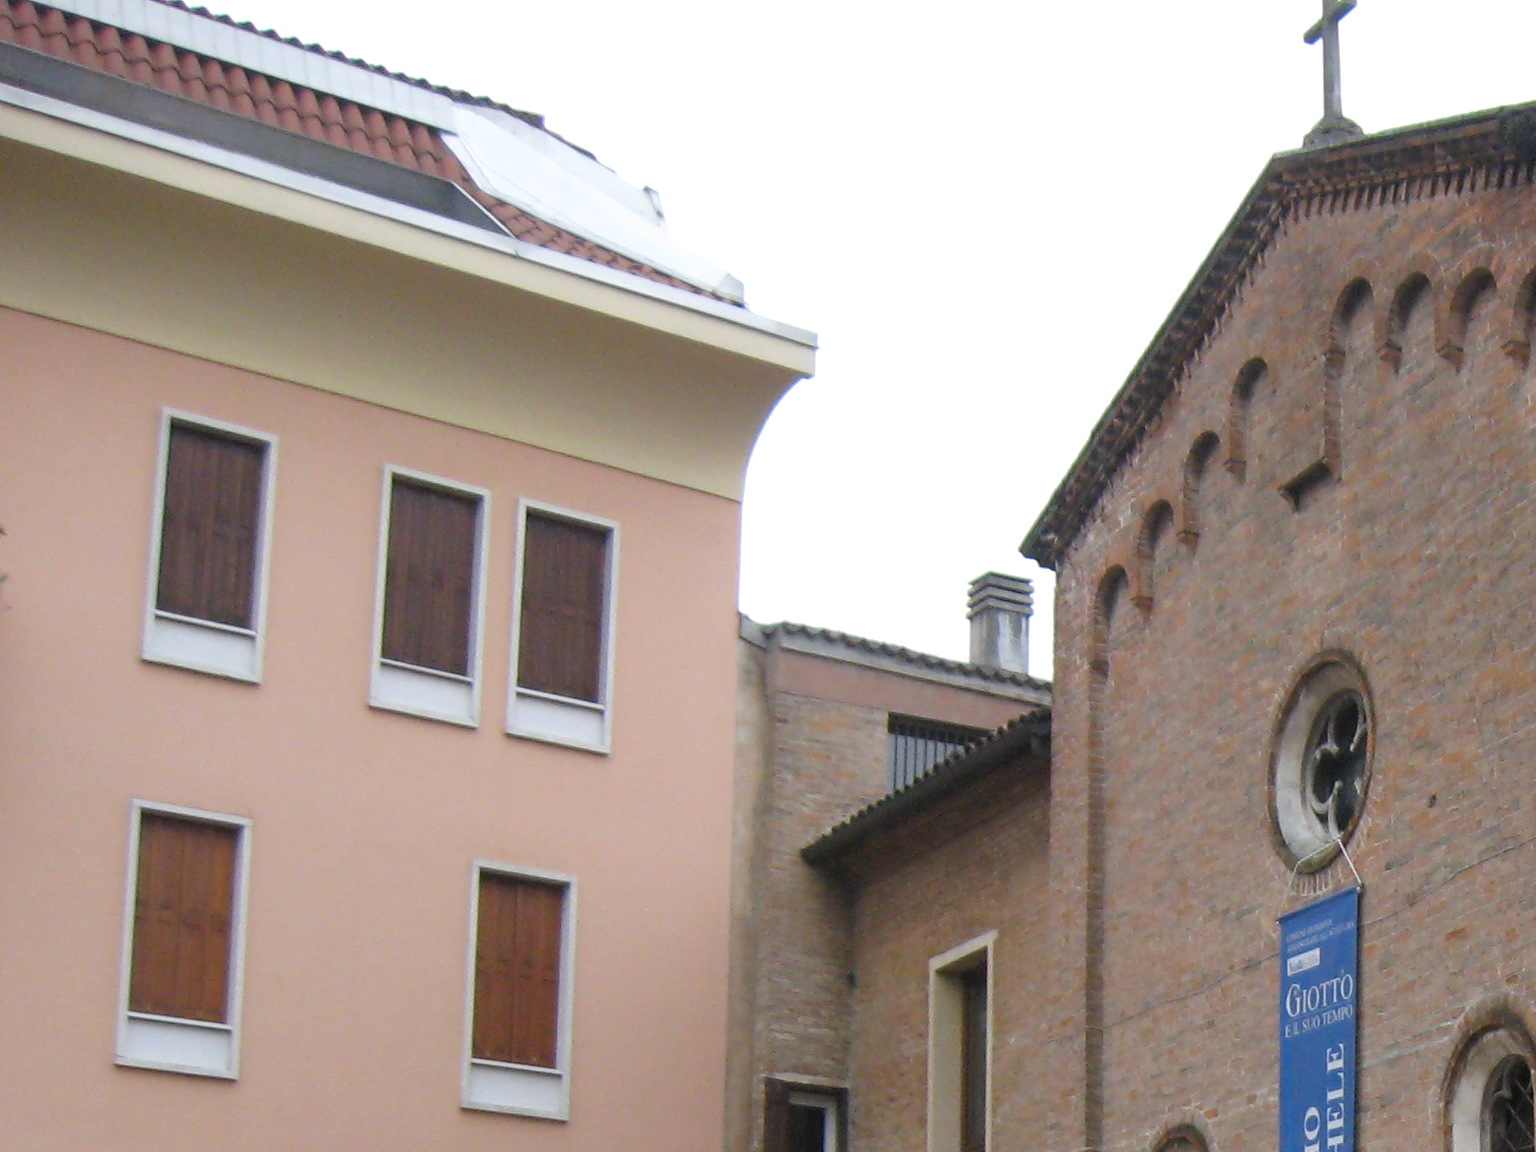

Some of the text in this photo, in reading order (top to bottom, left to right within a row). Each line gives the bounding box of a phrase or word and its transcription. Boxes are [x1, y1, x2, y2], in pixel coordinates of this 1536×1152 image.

[1286, 974, 1353, 1017] GIOTTO
[1302, 1015, 1320, 1033] SUO
[1322, 1004, 1353, 1026] TEMPO
